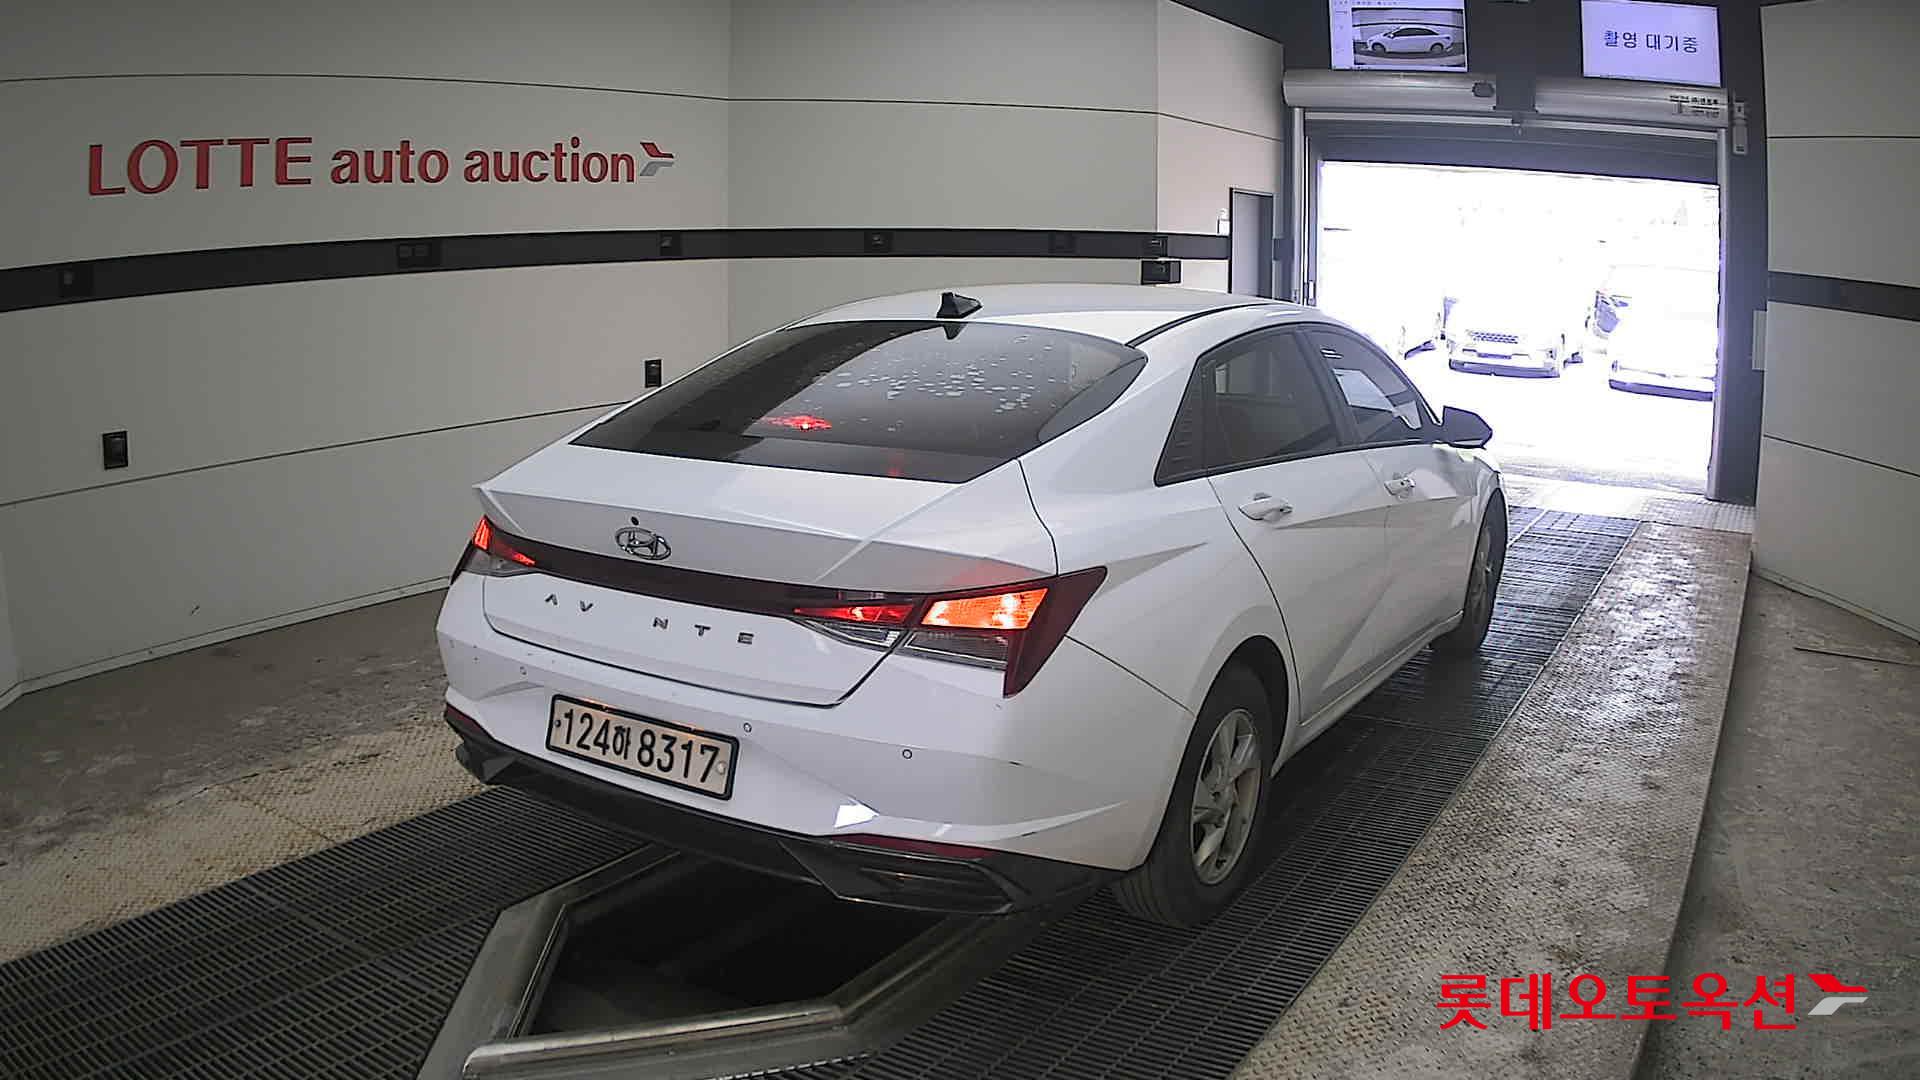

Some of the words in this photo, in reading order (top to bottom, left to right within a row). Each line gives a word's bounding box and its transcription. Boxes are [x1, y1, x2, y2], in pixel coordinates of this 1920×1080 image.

[1646, 34, 1697, 53] 대기중
[88, 138, 312, 196] LOTTE
[329, 140, 448, 184] auto
[463, 136, 635, 184] auction
